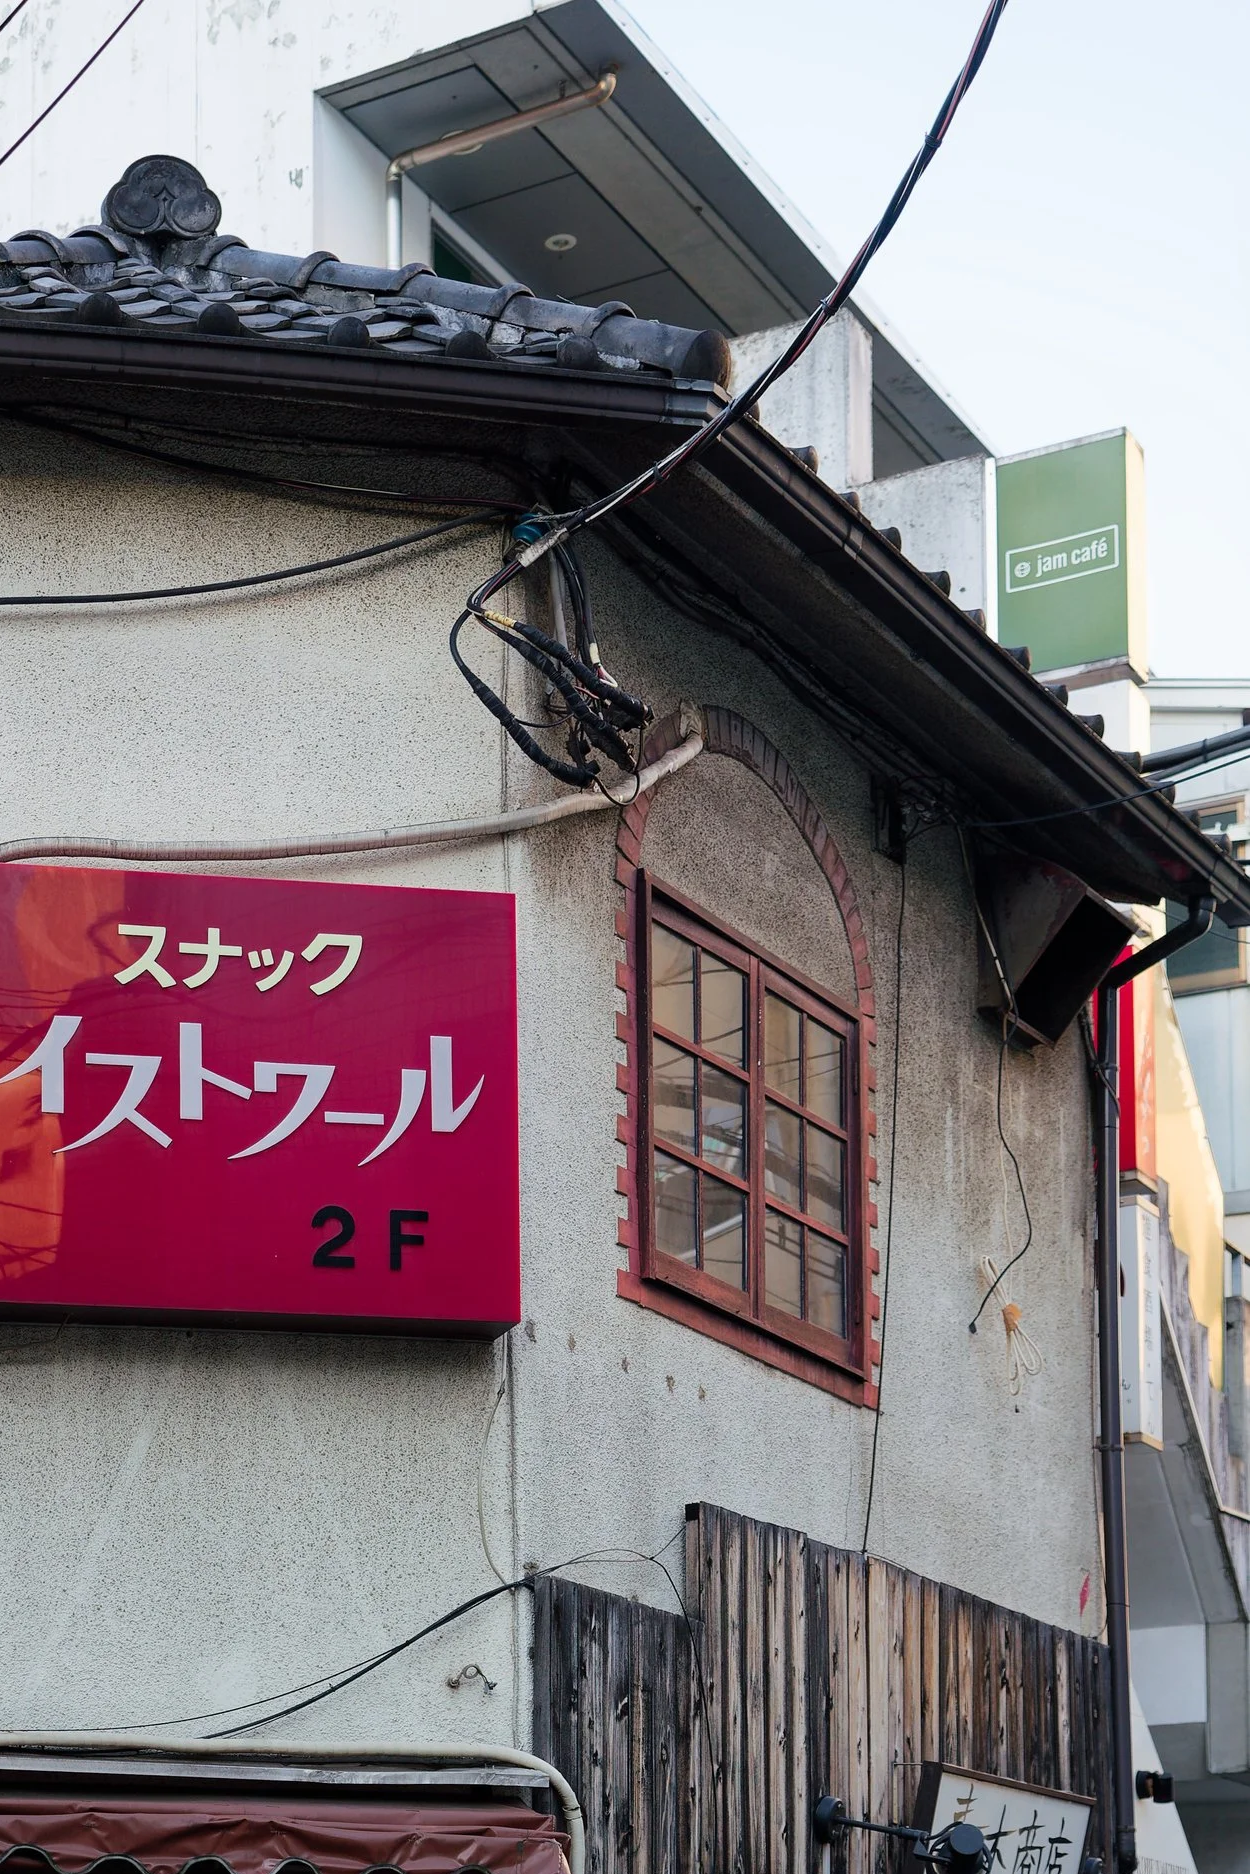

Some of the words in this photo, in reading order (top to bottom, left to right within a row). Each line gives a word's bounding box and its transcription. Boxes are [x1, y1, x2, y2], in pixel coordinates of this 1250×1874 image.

[1035, 552, 1067, 577] jam
[1070, 536, 1108, 565] café
[113, 923, 363, 996] スナック
